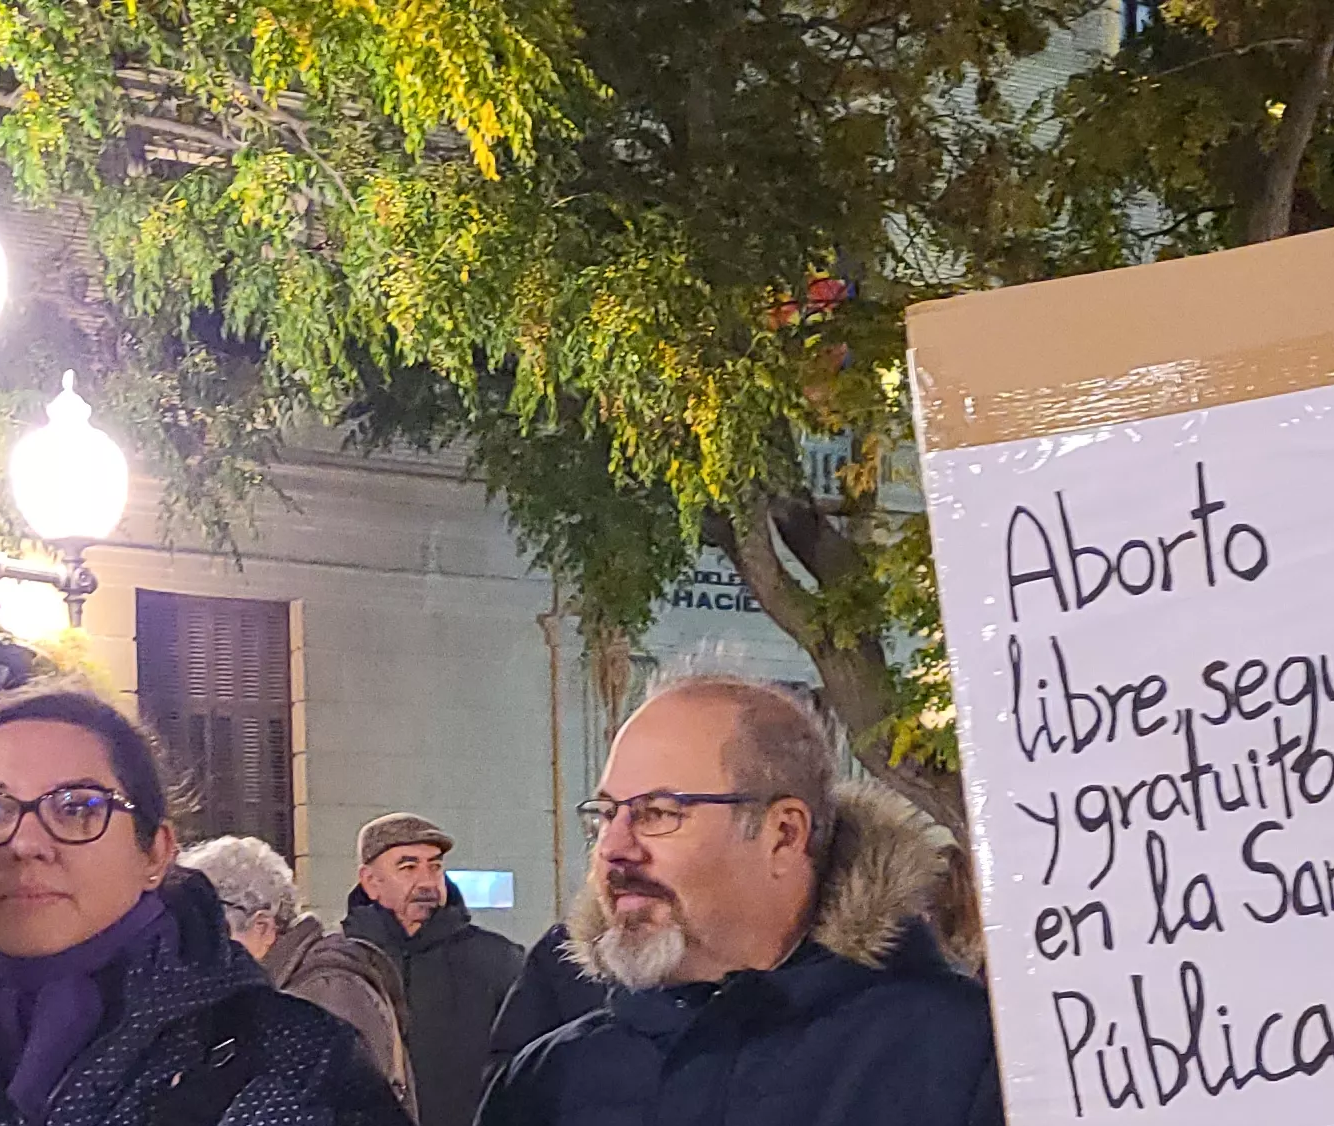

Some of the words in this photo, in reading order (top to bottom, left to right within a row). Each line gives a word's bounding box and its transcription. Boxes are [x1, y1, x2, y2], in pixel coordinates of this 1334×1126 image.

[1006, 461, 1269, 622] Aborto
[1015, 791, 1060, 885] y
[1034, 900, 1114, 961] en
[1146, 829, 1224, 945] la
